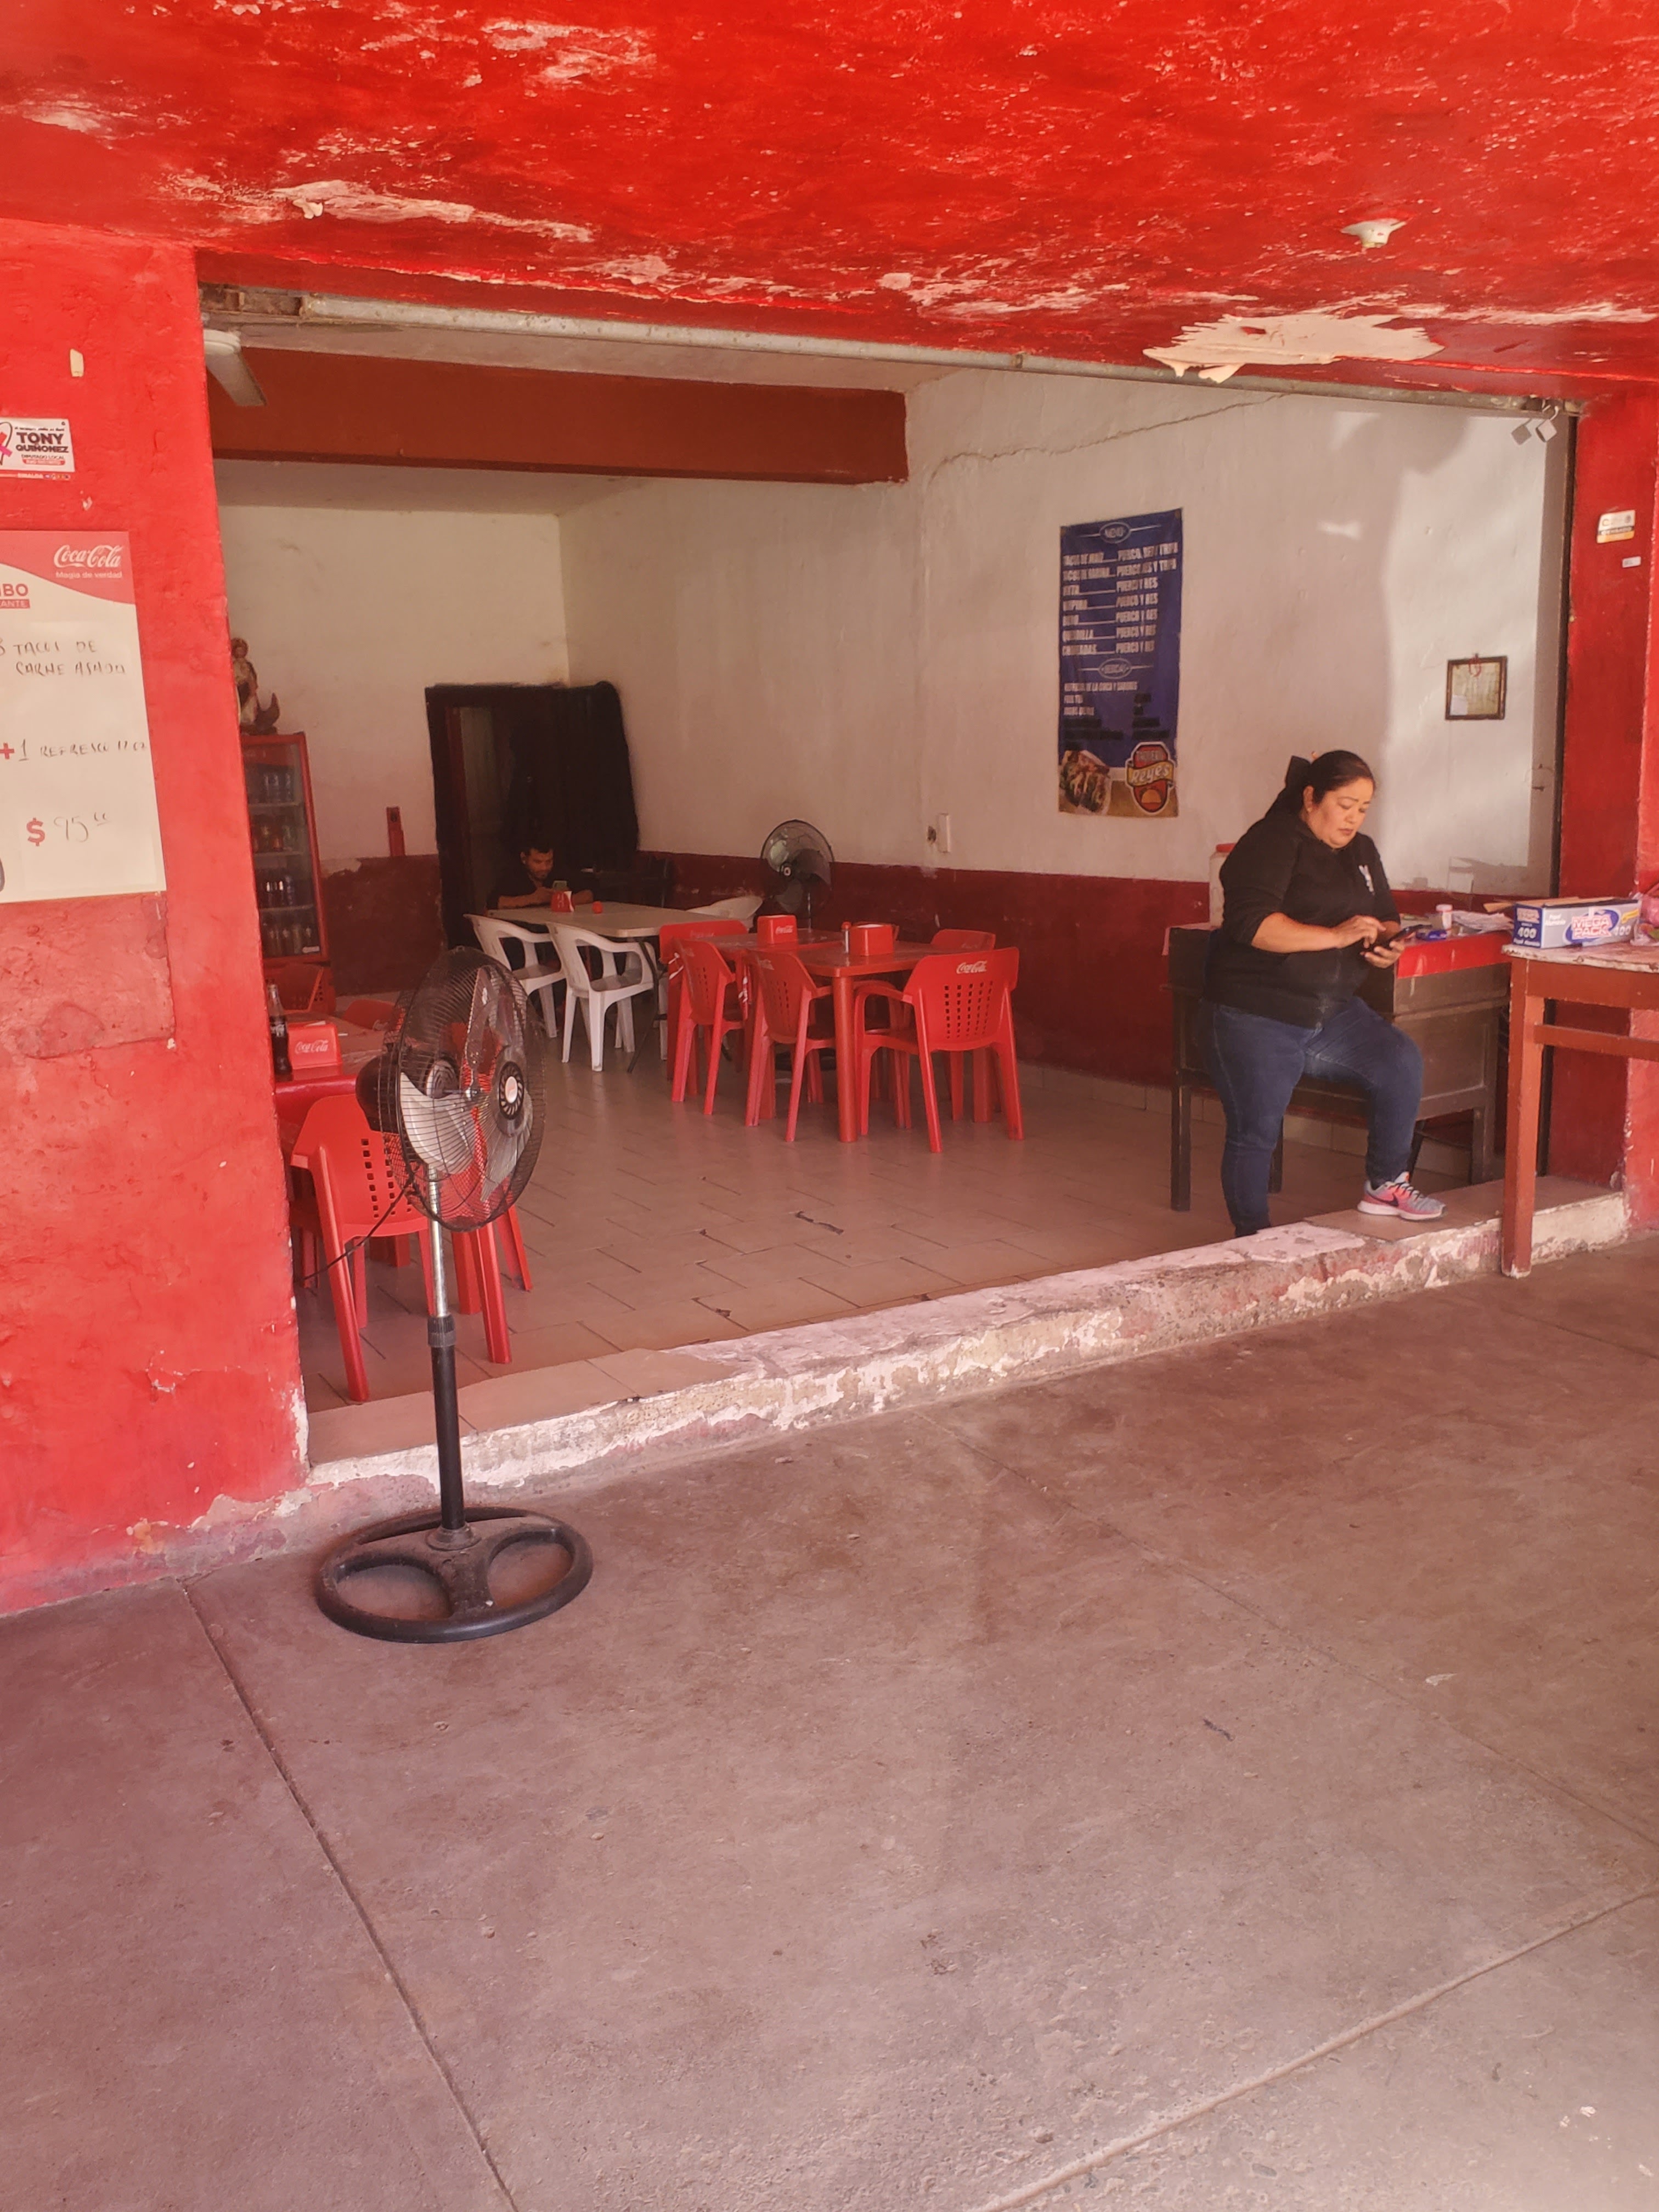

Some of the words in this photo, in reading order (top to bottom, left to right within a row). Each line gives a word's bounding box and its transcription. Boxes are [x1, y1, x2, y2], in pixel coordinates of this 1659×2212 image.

[16, 432, 64, 445] TONY
[56, 572, 81, 580] Magia
[0, 583, 29, 597] BO
[76, 640, 98, 653] DE
[15, 661, 65, 676] CARNE
[1130, 765, 1169, 784] Reyes
[1572, 915, 1611, 929] MEGA
[1517, 926, 1537, 939] 400
[1573, 925, 1611, 938] PACK
